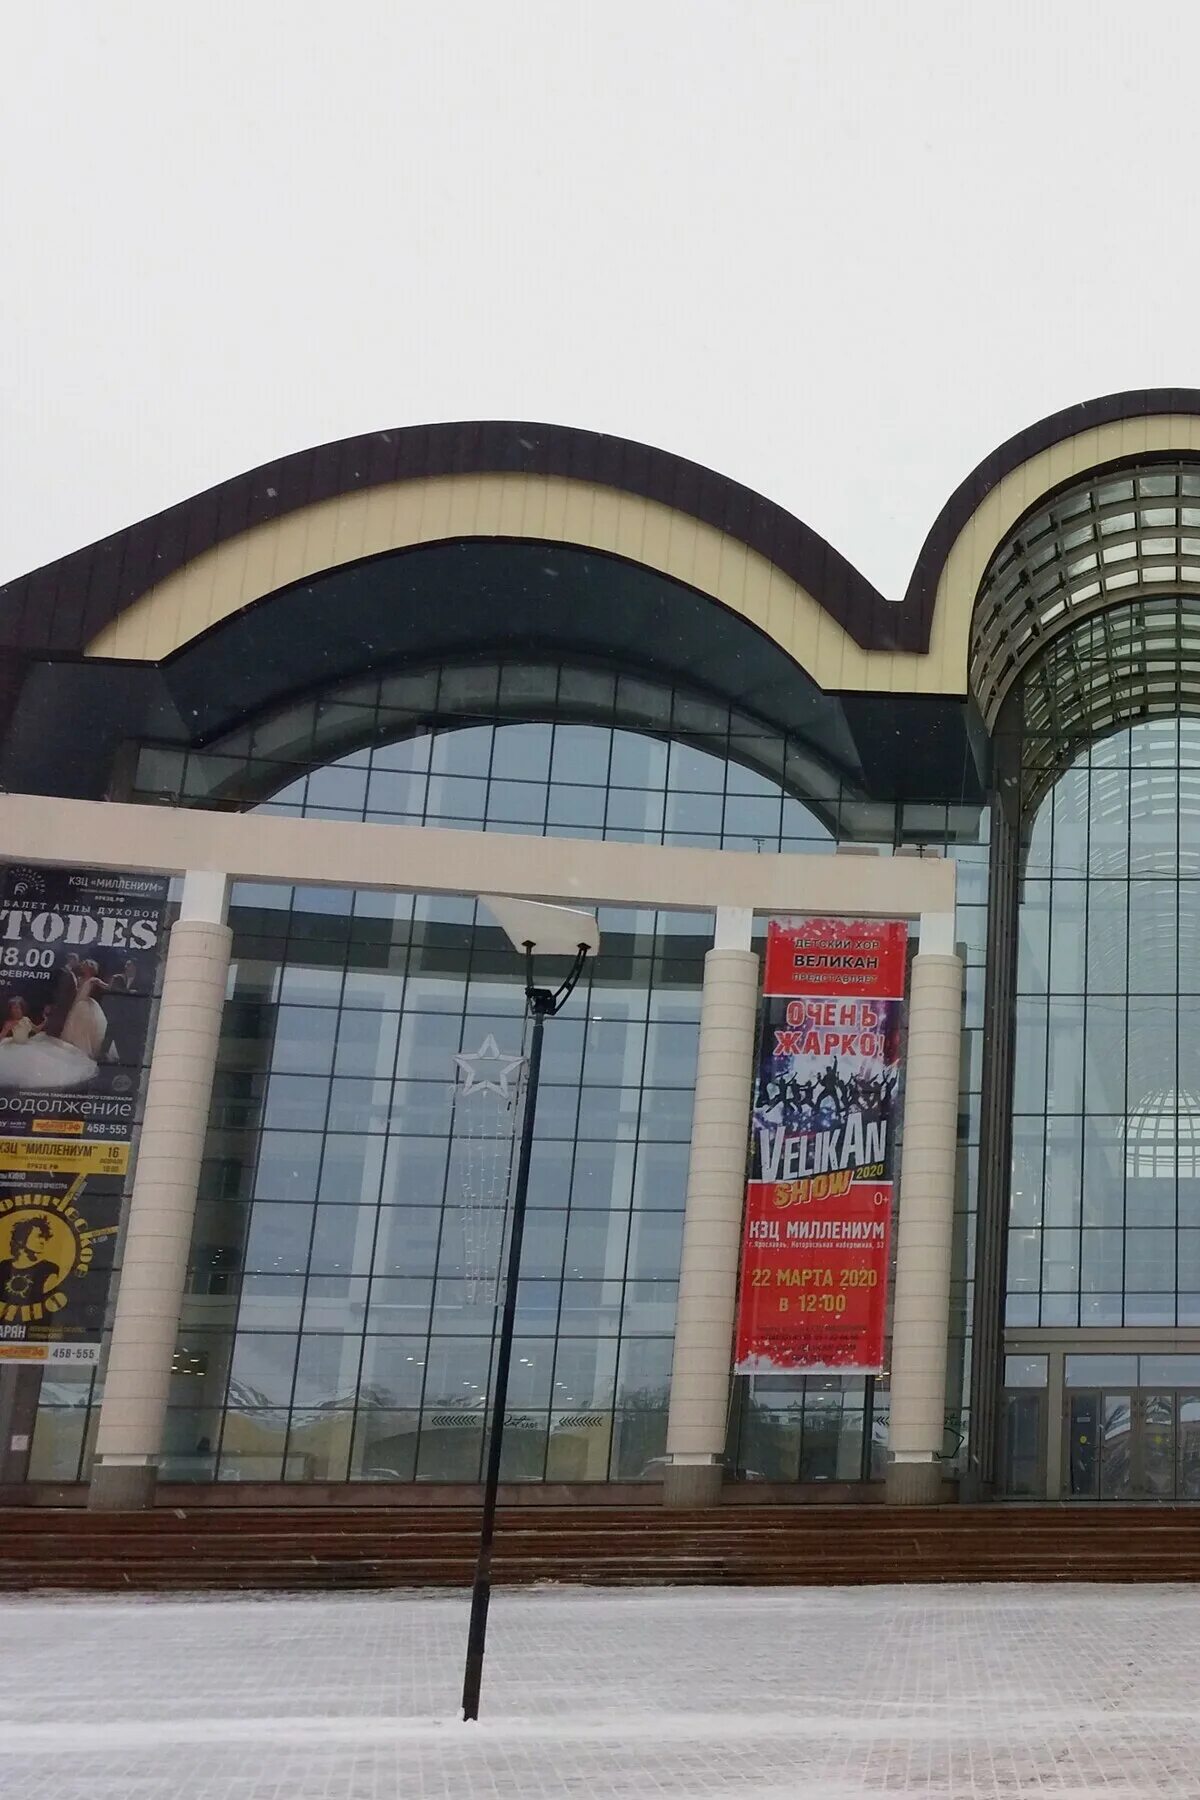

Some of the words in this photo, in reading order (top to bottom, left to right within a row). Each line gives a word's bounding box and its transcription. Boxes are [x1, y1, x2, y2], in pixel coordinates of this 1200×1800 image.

[69, 876, 88, 886] КЗЦ
[91, 877, 164, 892] «МИЛЛЕНИУМ»
[3, 900, 47, 910] БАЛЕТ
[53, 904, 91, 913] АЛЛЫ
[97, 907, 159, 919] ДУХОВОЙ
[0, 909, 158, 950] TODES
[857, 940, 879, 950] ХОР
[793, 954, 879, 970] ВЕЛИКАН
[786, 1001, 878, 1028] ОЧЕНЬ
[773, 1031, 885, 1057] ЖАРКО!
[87, 1123, 127, 1135] 458-555
[107, 1146, 120, 1158] 16
[760, 1112, 887, 1185] VELIKAN
[773, 1170, 855, 1209] SHOW
[856, 1163, 884, 1180] 2020
[874, 1191, 890, 1206] 0+
[749, 1221, 780, 1242] КЗЦ
[786, 1221, 885, 1240] МИЛЛЕНИУМ
[751, 1269, 771, 1287] 22
[776, 1269, 833, 1287] МАРТА
[839, 1269, 878, 1287] 2020
[799, 1294, 846, 1312] 12:00
[52, 1348, 95, 1359] 458-555
